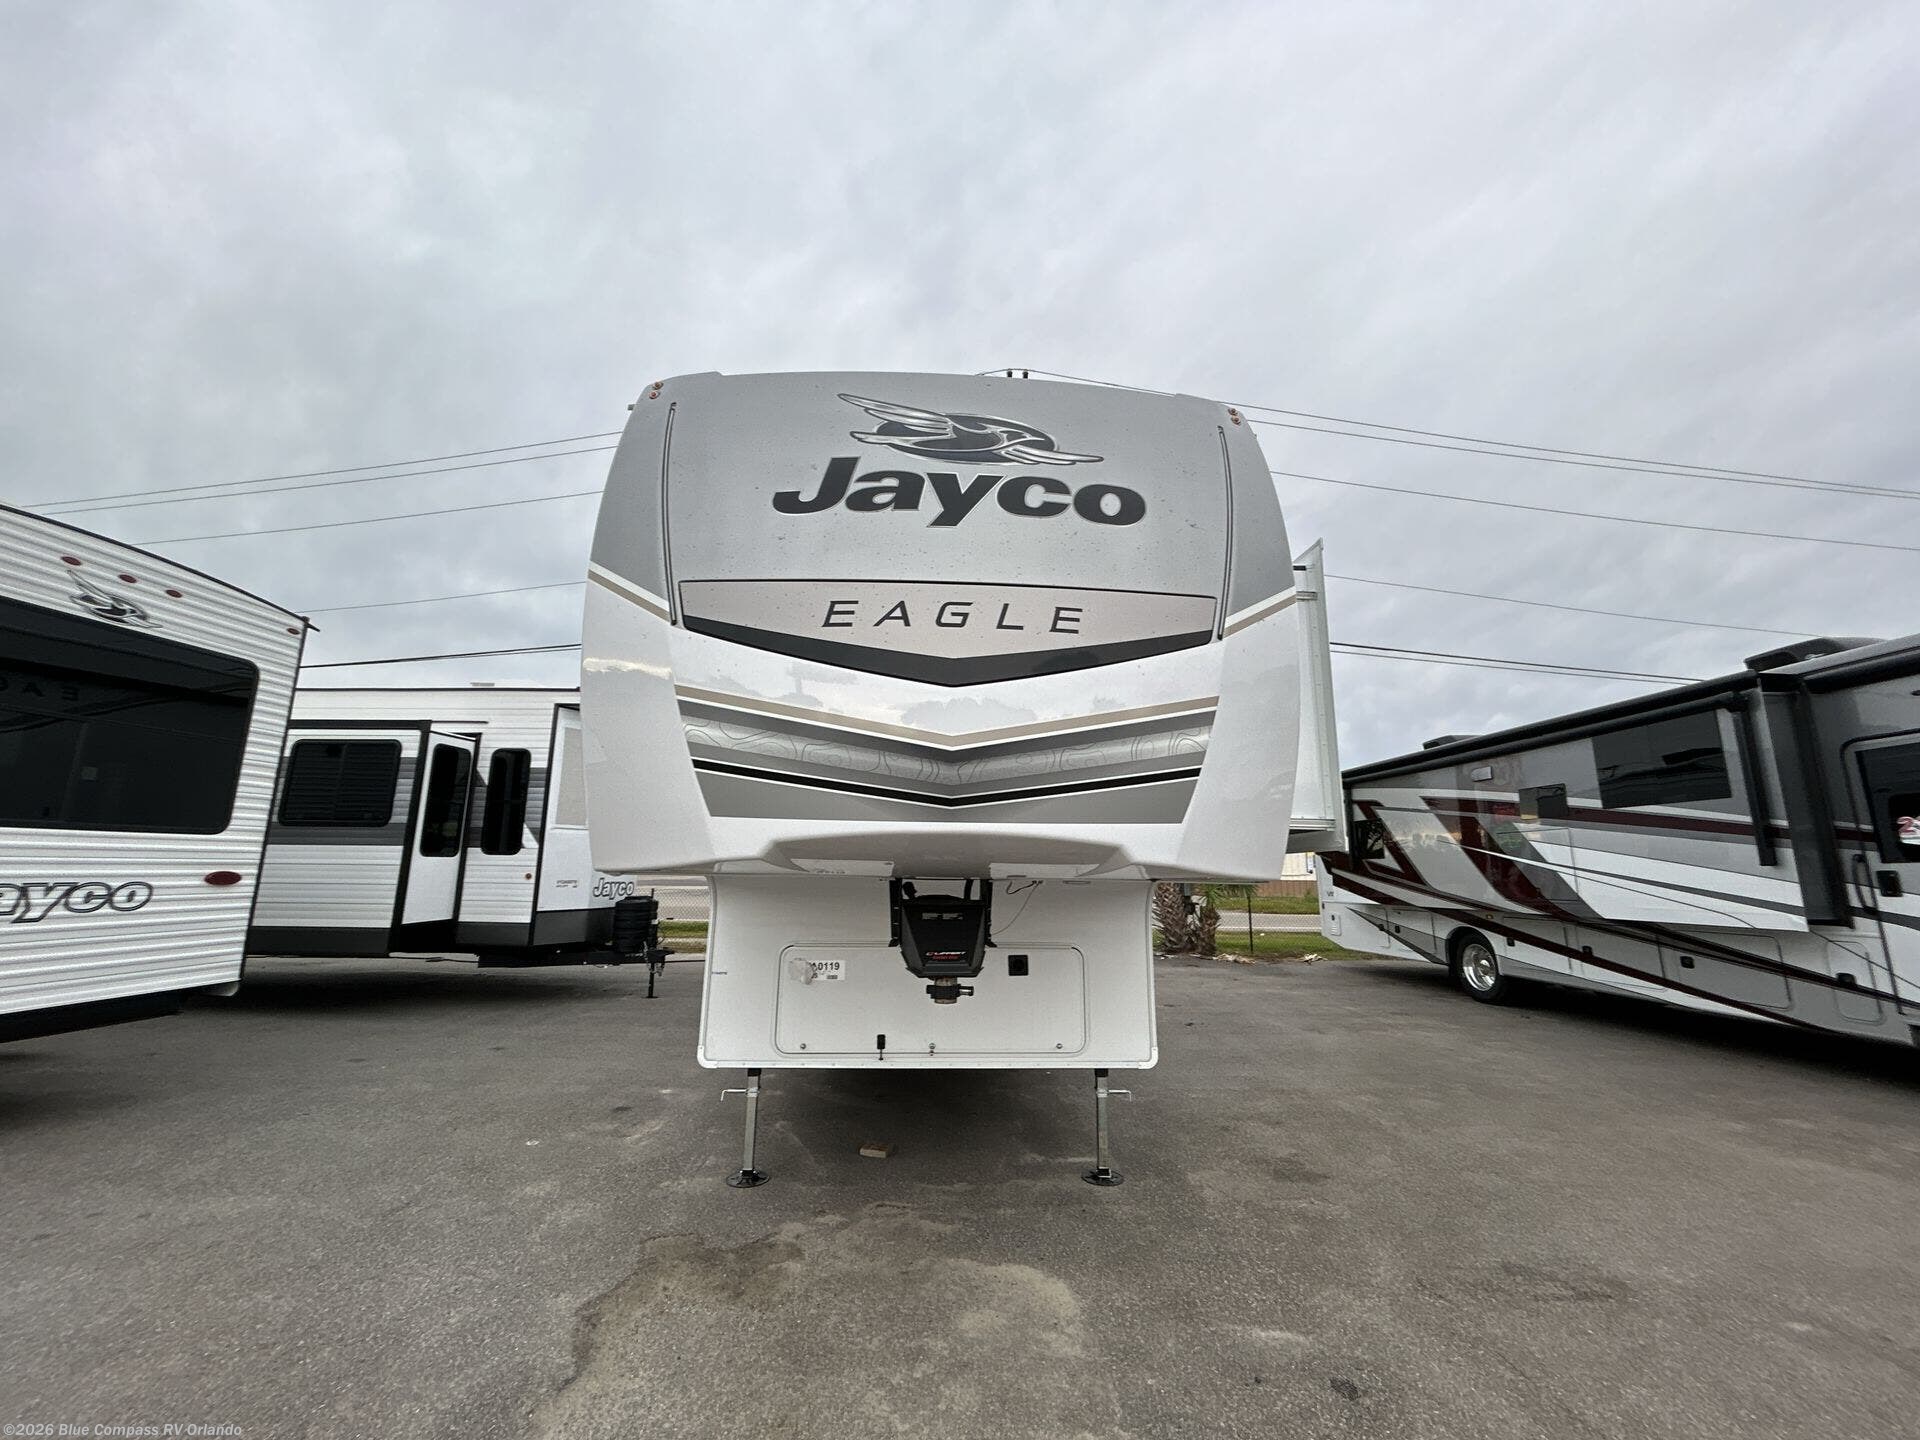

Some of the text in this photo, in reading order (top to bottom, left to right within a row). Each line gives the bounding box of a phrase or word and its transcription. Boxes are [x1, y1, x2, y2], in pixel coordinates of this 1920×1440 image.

[772, 457, 1146, 528] Jayco
[821, 600, 1084, 634] EAGLE
[593, 877, 634, 899] Jayco
